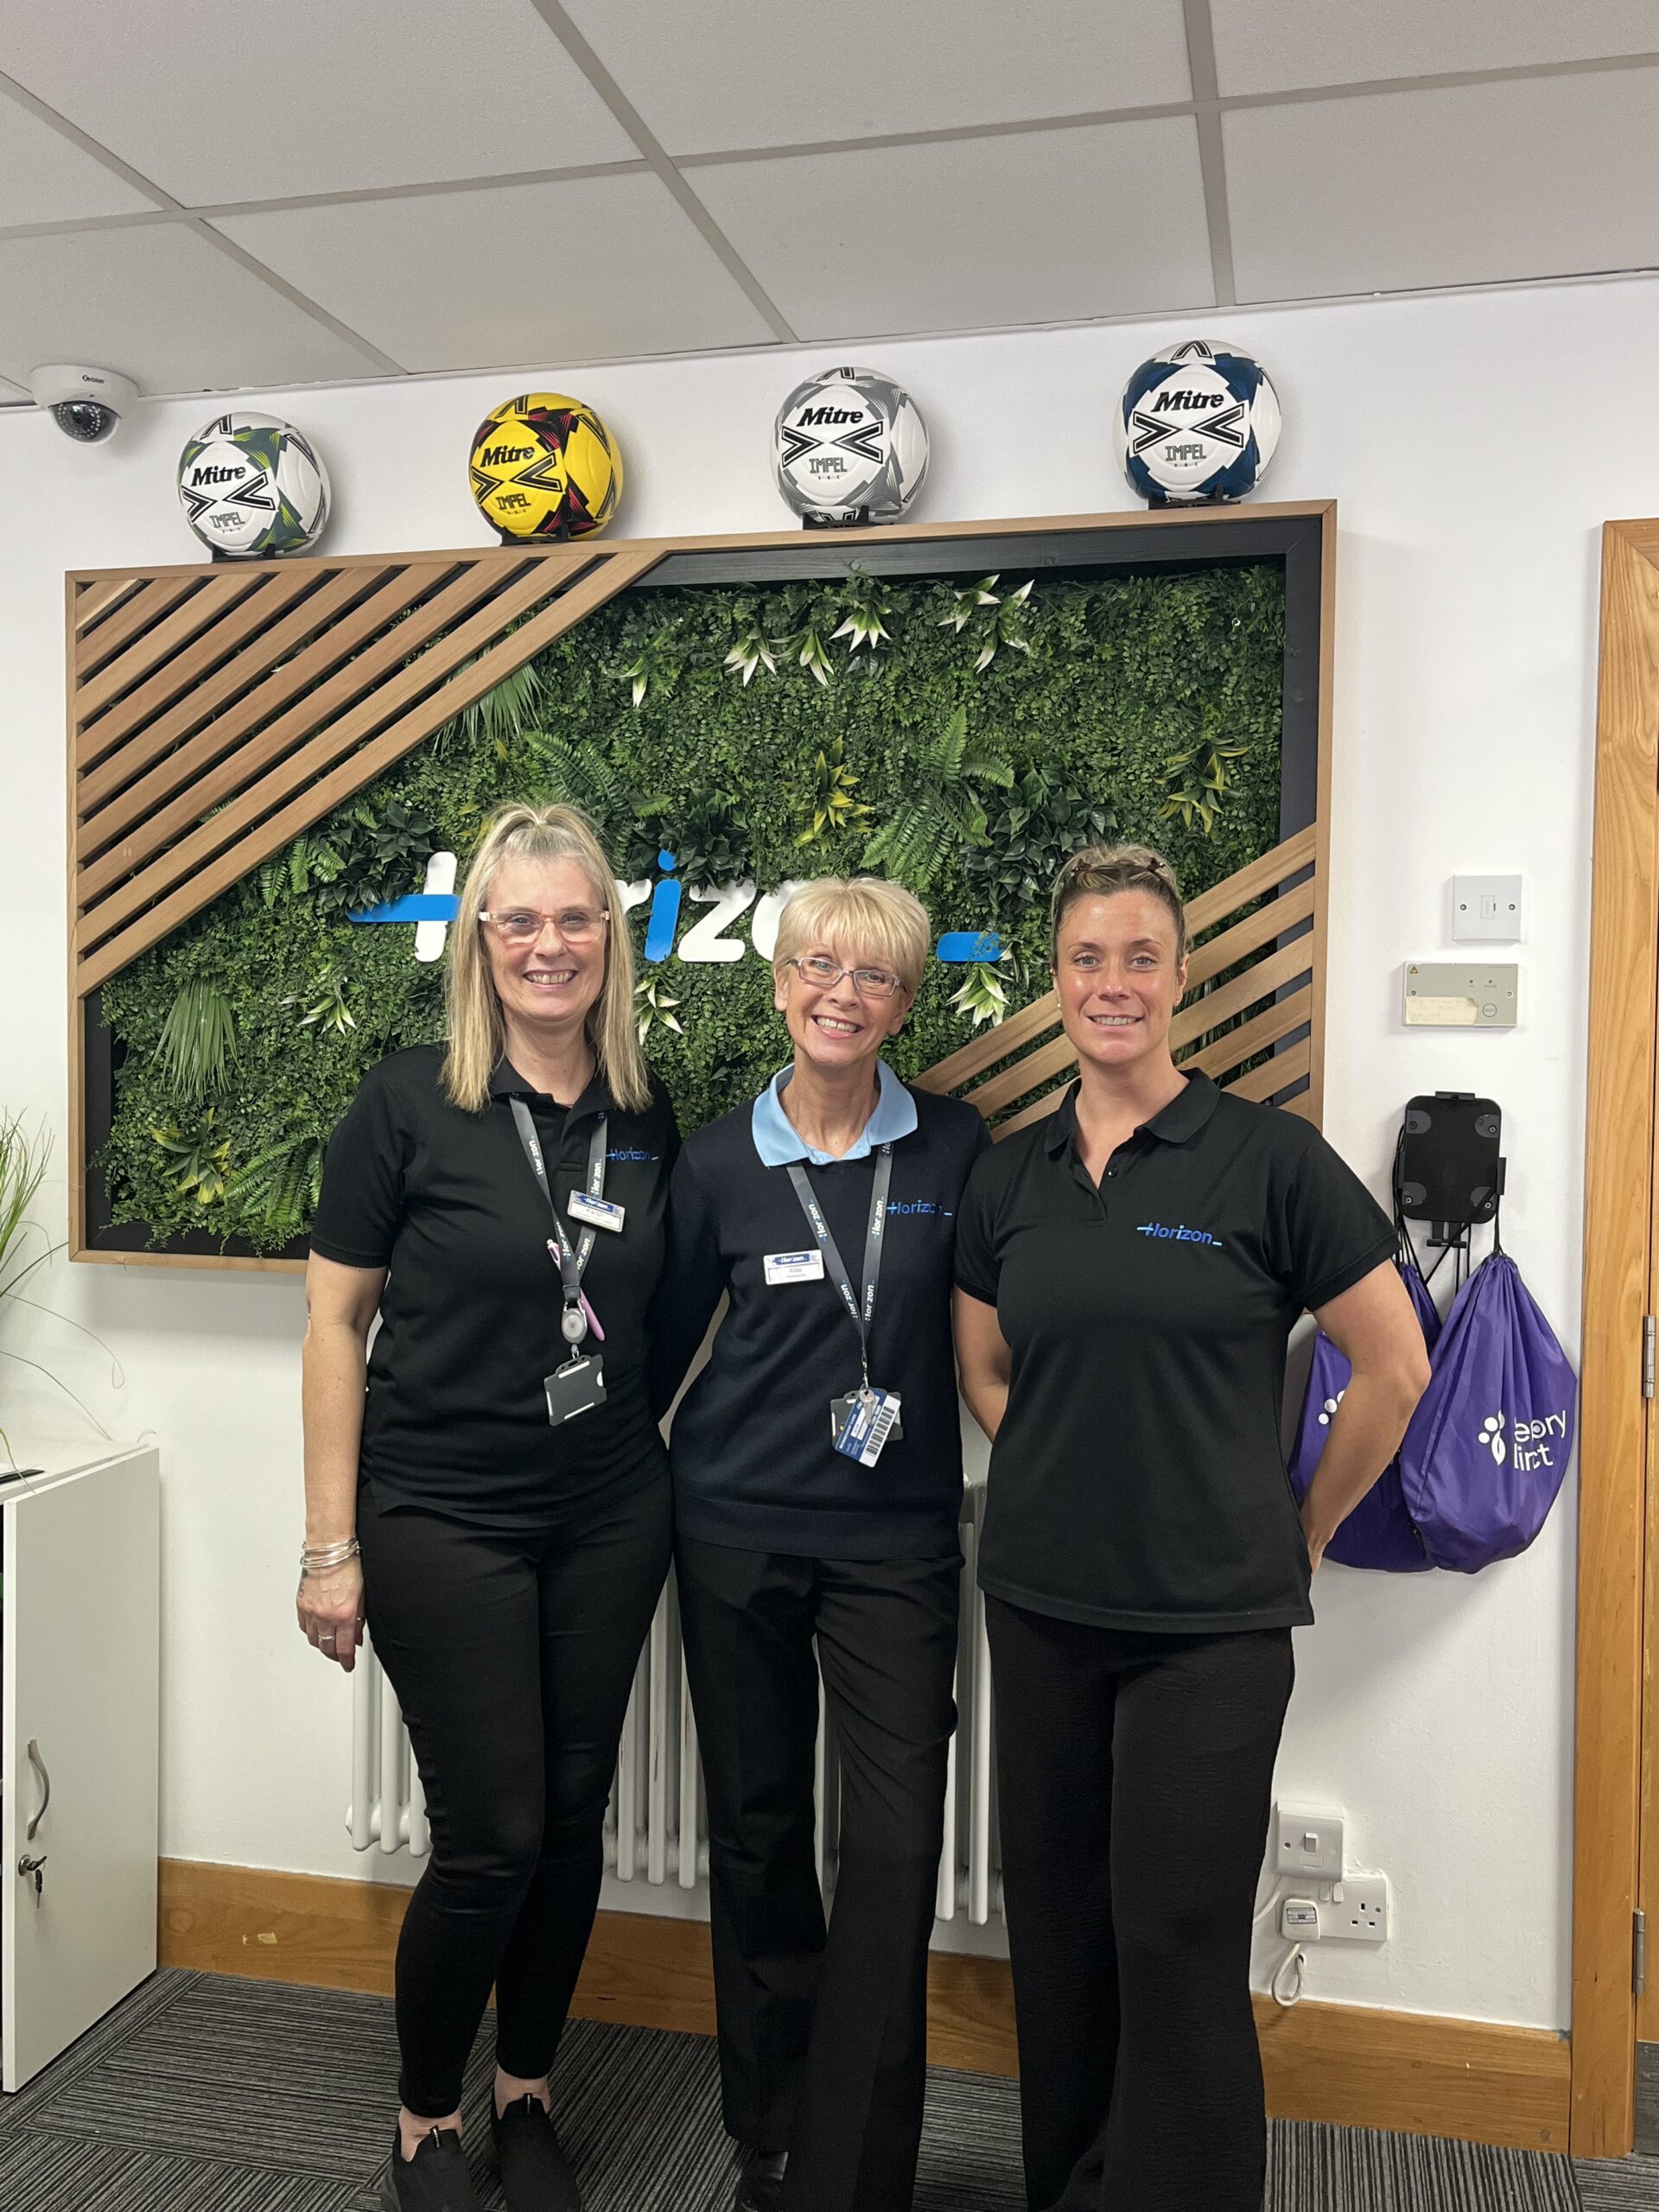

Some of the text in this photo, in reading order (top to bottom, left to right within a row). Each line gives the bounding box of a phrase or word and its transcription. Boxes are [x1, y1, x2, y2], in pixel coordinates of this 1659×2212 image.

[1151, 391, 1224, 412] Mitre
[796, 406, 863, 427] Mitre
[480, 445, 535, 467] Mitre
[1165, 444, 1207, 461] IMPEL
[190, 465, 246, 487] Mitre
[809, 457, 848, 474] IMPEL
[495, 493, 531, 511] IMPEL
[209, 512, 245, 530] IMPEL
[1136, 1222, 1214, 1245] Horizon
